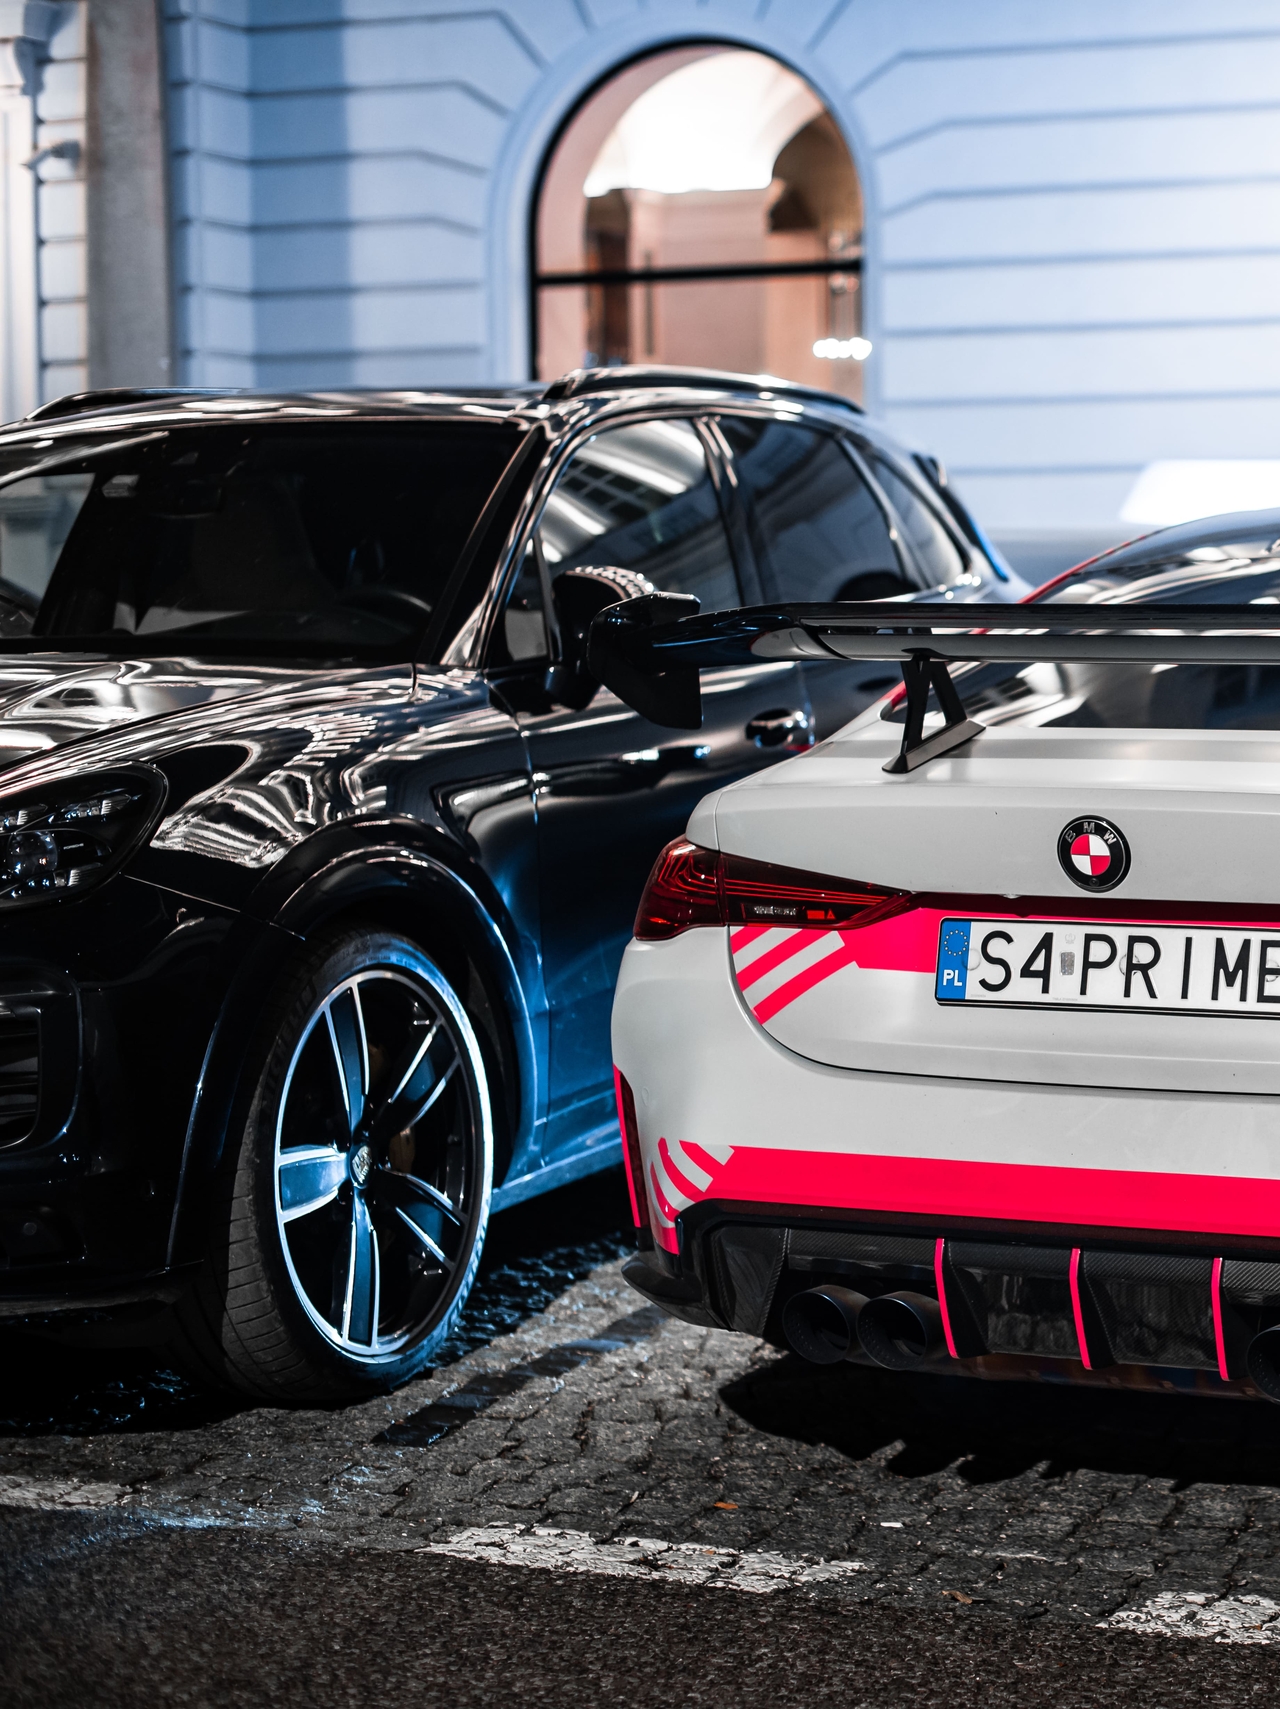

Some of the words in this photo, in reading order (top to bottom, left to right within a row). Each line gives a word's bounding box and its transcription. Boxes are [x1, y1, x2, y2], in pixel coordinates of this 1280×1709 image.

[1064, 821, 1117, 845] BMW
[978, 930, 1054, 994] S4
[943, 968, 963, 987] PL
